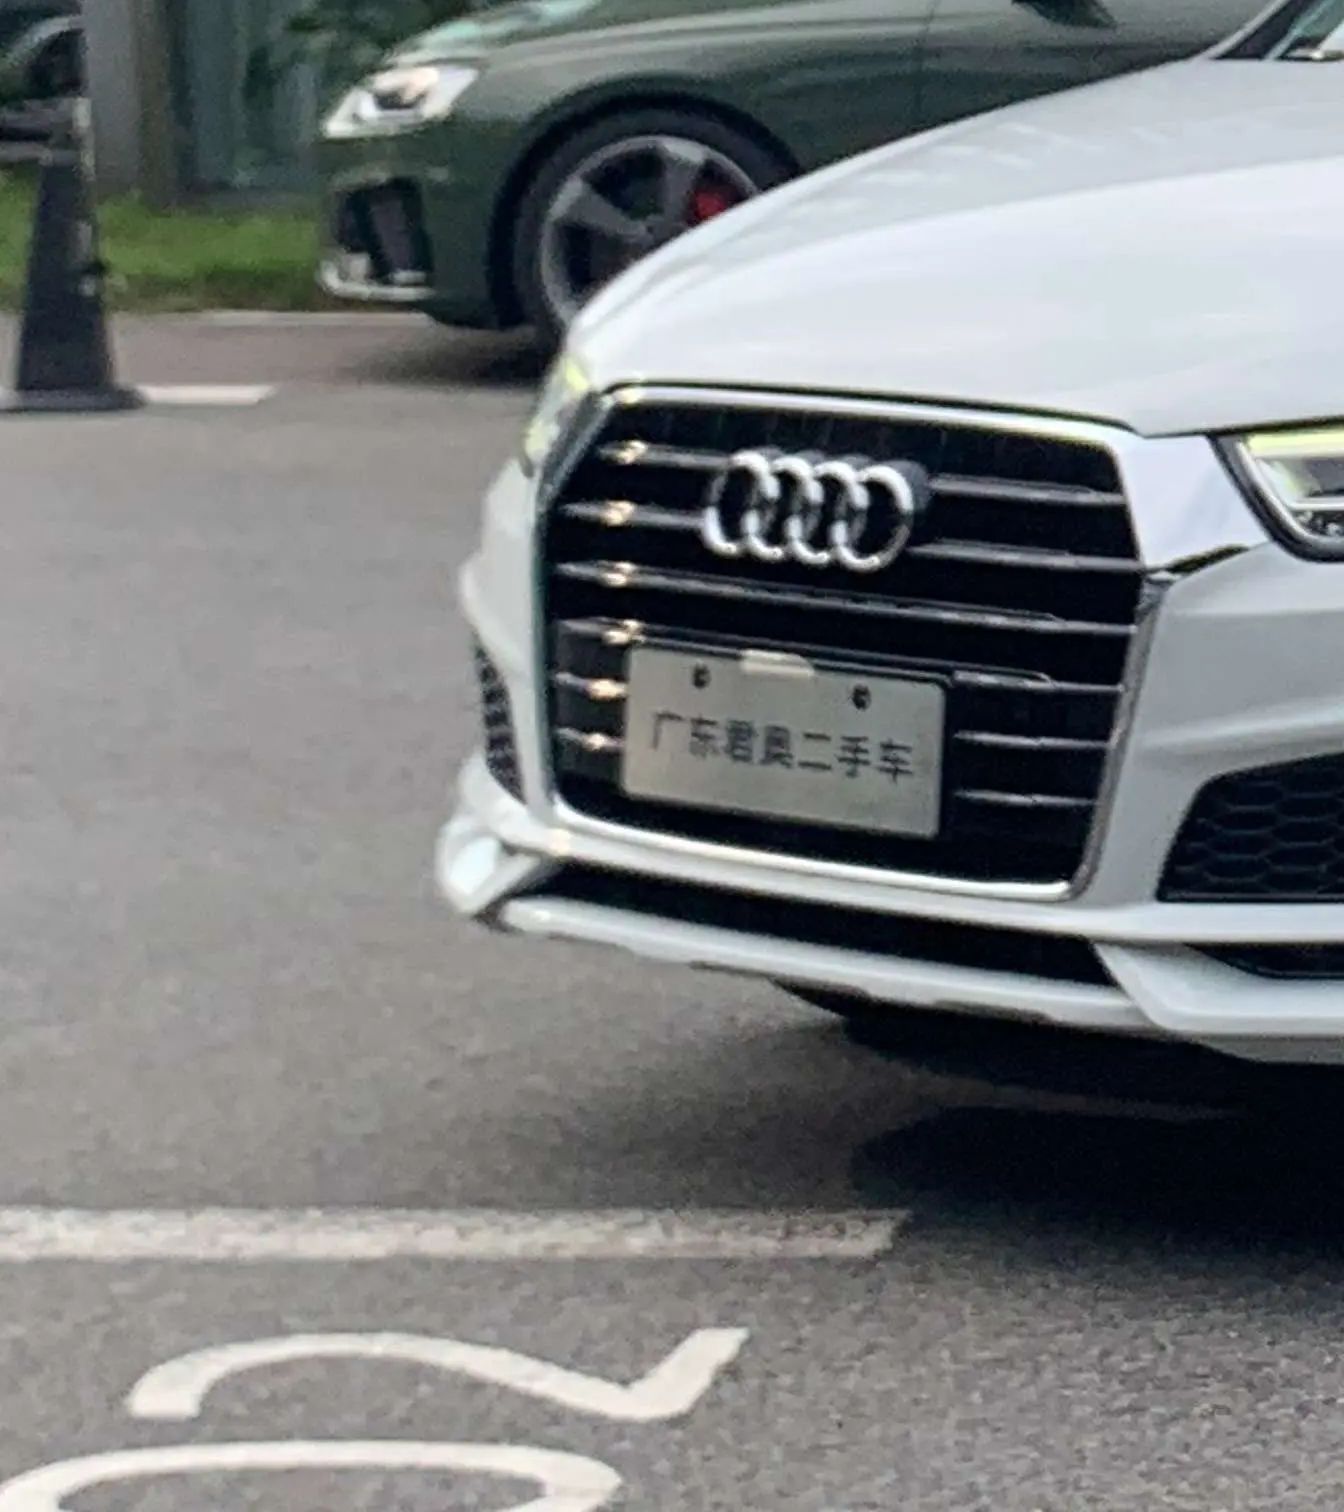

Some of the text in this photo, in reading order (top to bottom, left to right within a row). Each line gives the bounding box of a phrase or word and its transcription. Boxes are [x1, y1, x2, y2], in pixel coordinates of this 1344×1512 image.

[651, 709, 914, 785] 广东君奥二手车
